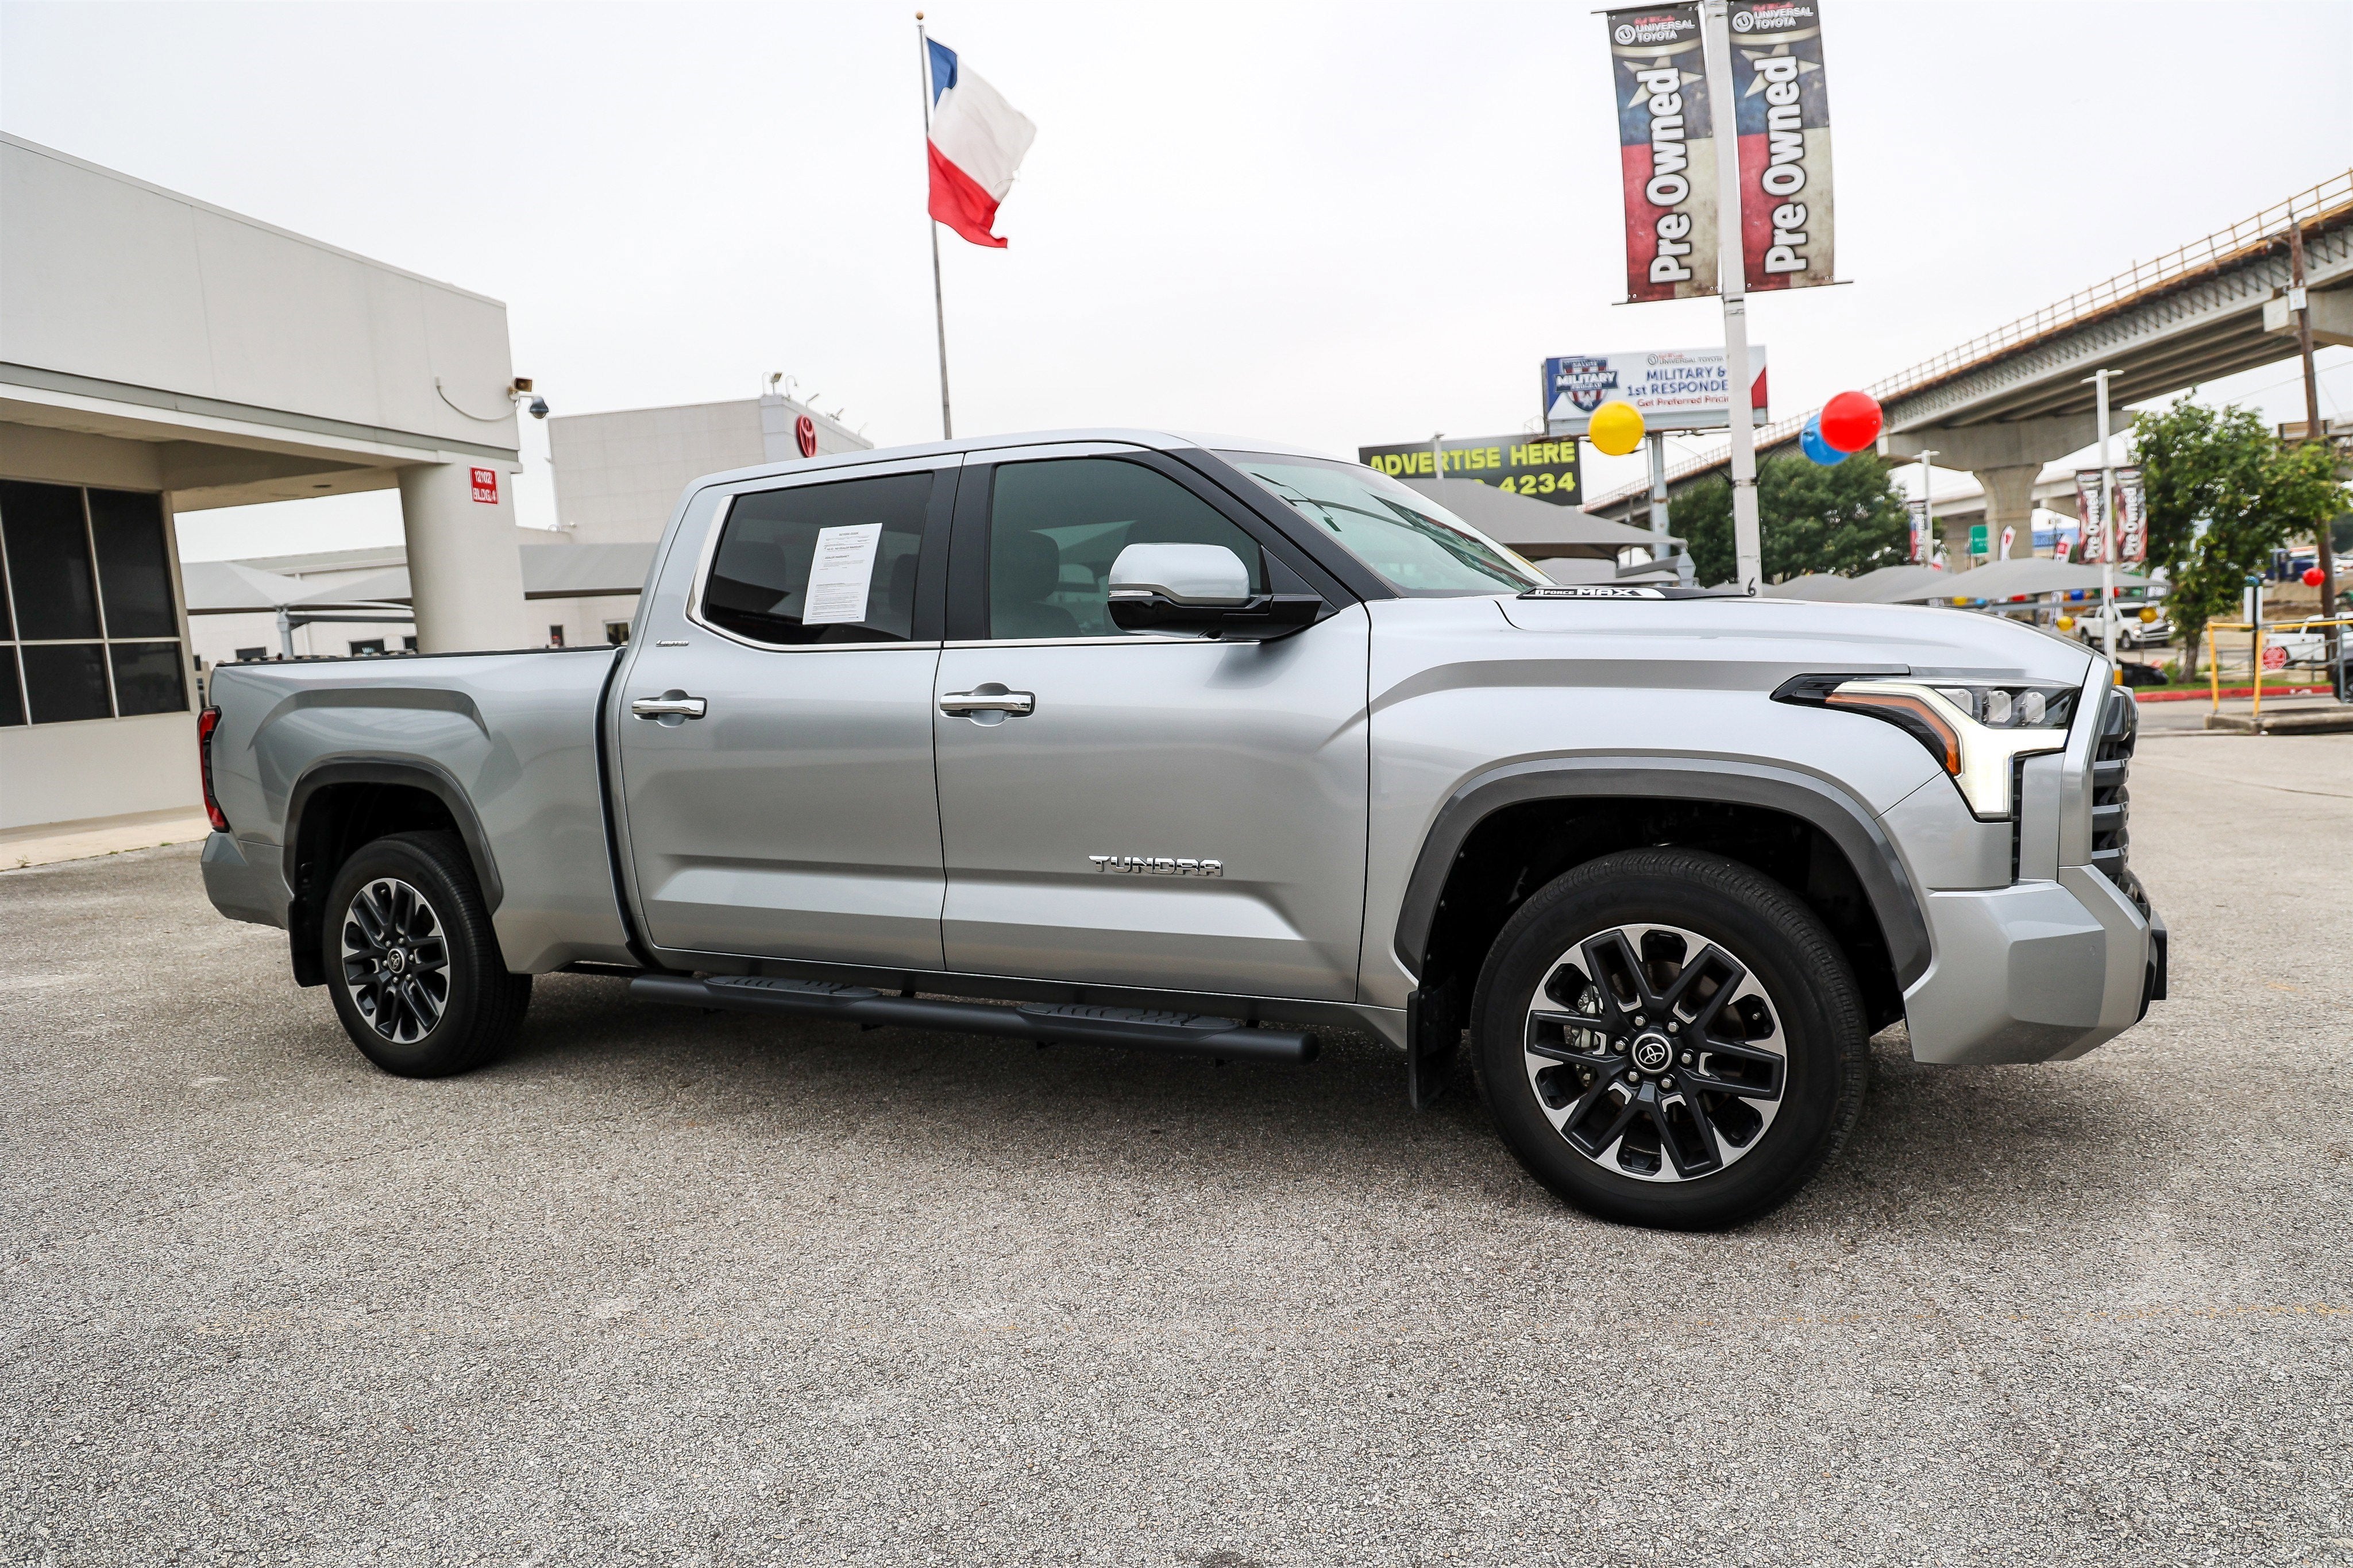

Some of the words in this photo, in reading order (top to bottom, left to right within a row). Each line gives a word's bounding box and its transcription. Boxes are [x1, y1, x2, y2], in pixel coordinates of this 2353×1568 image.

[1753, 6, 1814, 20] UNIVERSAL
[1635, 19, 1695, 32] UNIVERSAL
[1754, 16, 1797, 30] TOYOTA
[1637, 29, 1678, 43] TOYOTA
[1754, 56, 1806, 196] Owned
[1636, 67, 1690, 206] Owned
[1765, 202, 1808, 273] Pre
[1650, 213, 1691, 284] Pre
[1556, 372, 1616, 386] MILITARY
[1647, 366, 1714, 381] MILITARY
[1627, 384, 1648, 396] 1st
[1638, 399, 1655, 407] Get
[1371, 447, 1501, 476] ADVERTISE
[1509, 442, 1576, 467] HERE
[475, 470, 493, 484] 12102
[2121, 488, 2139, 534] Owned
[1088, 855, 1224, 876] TUNDRA
